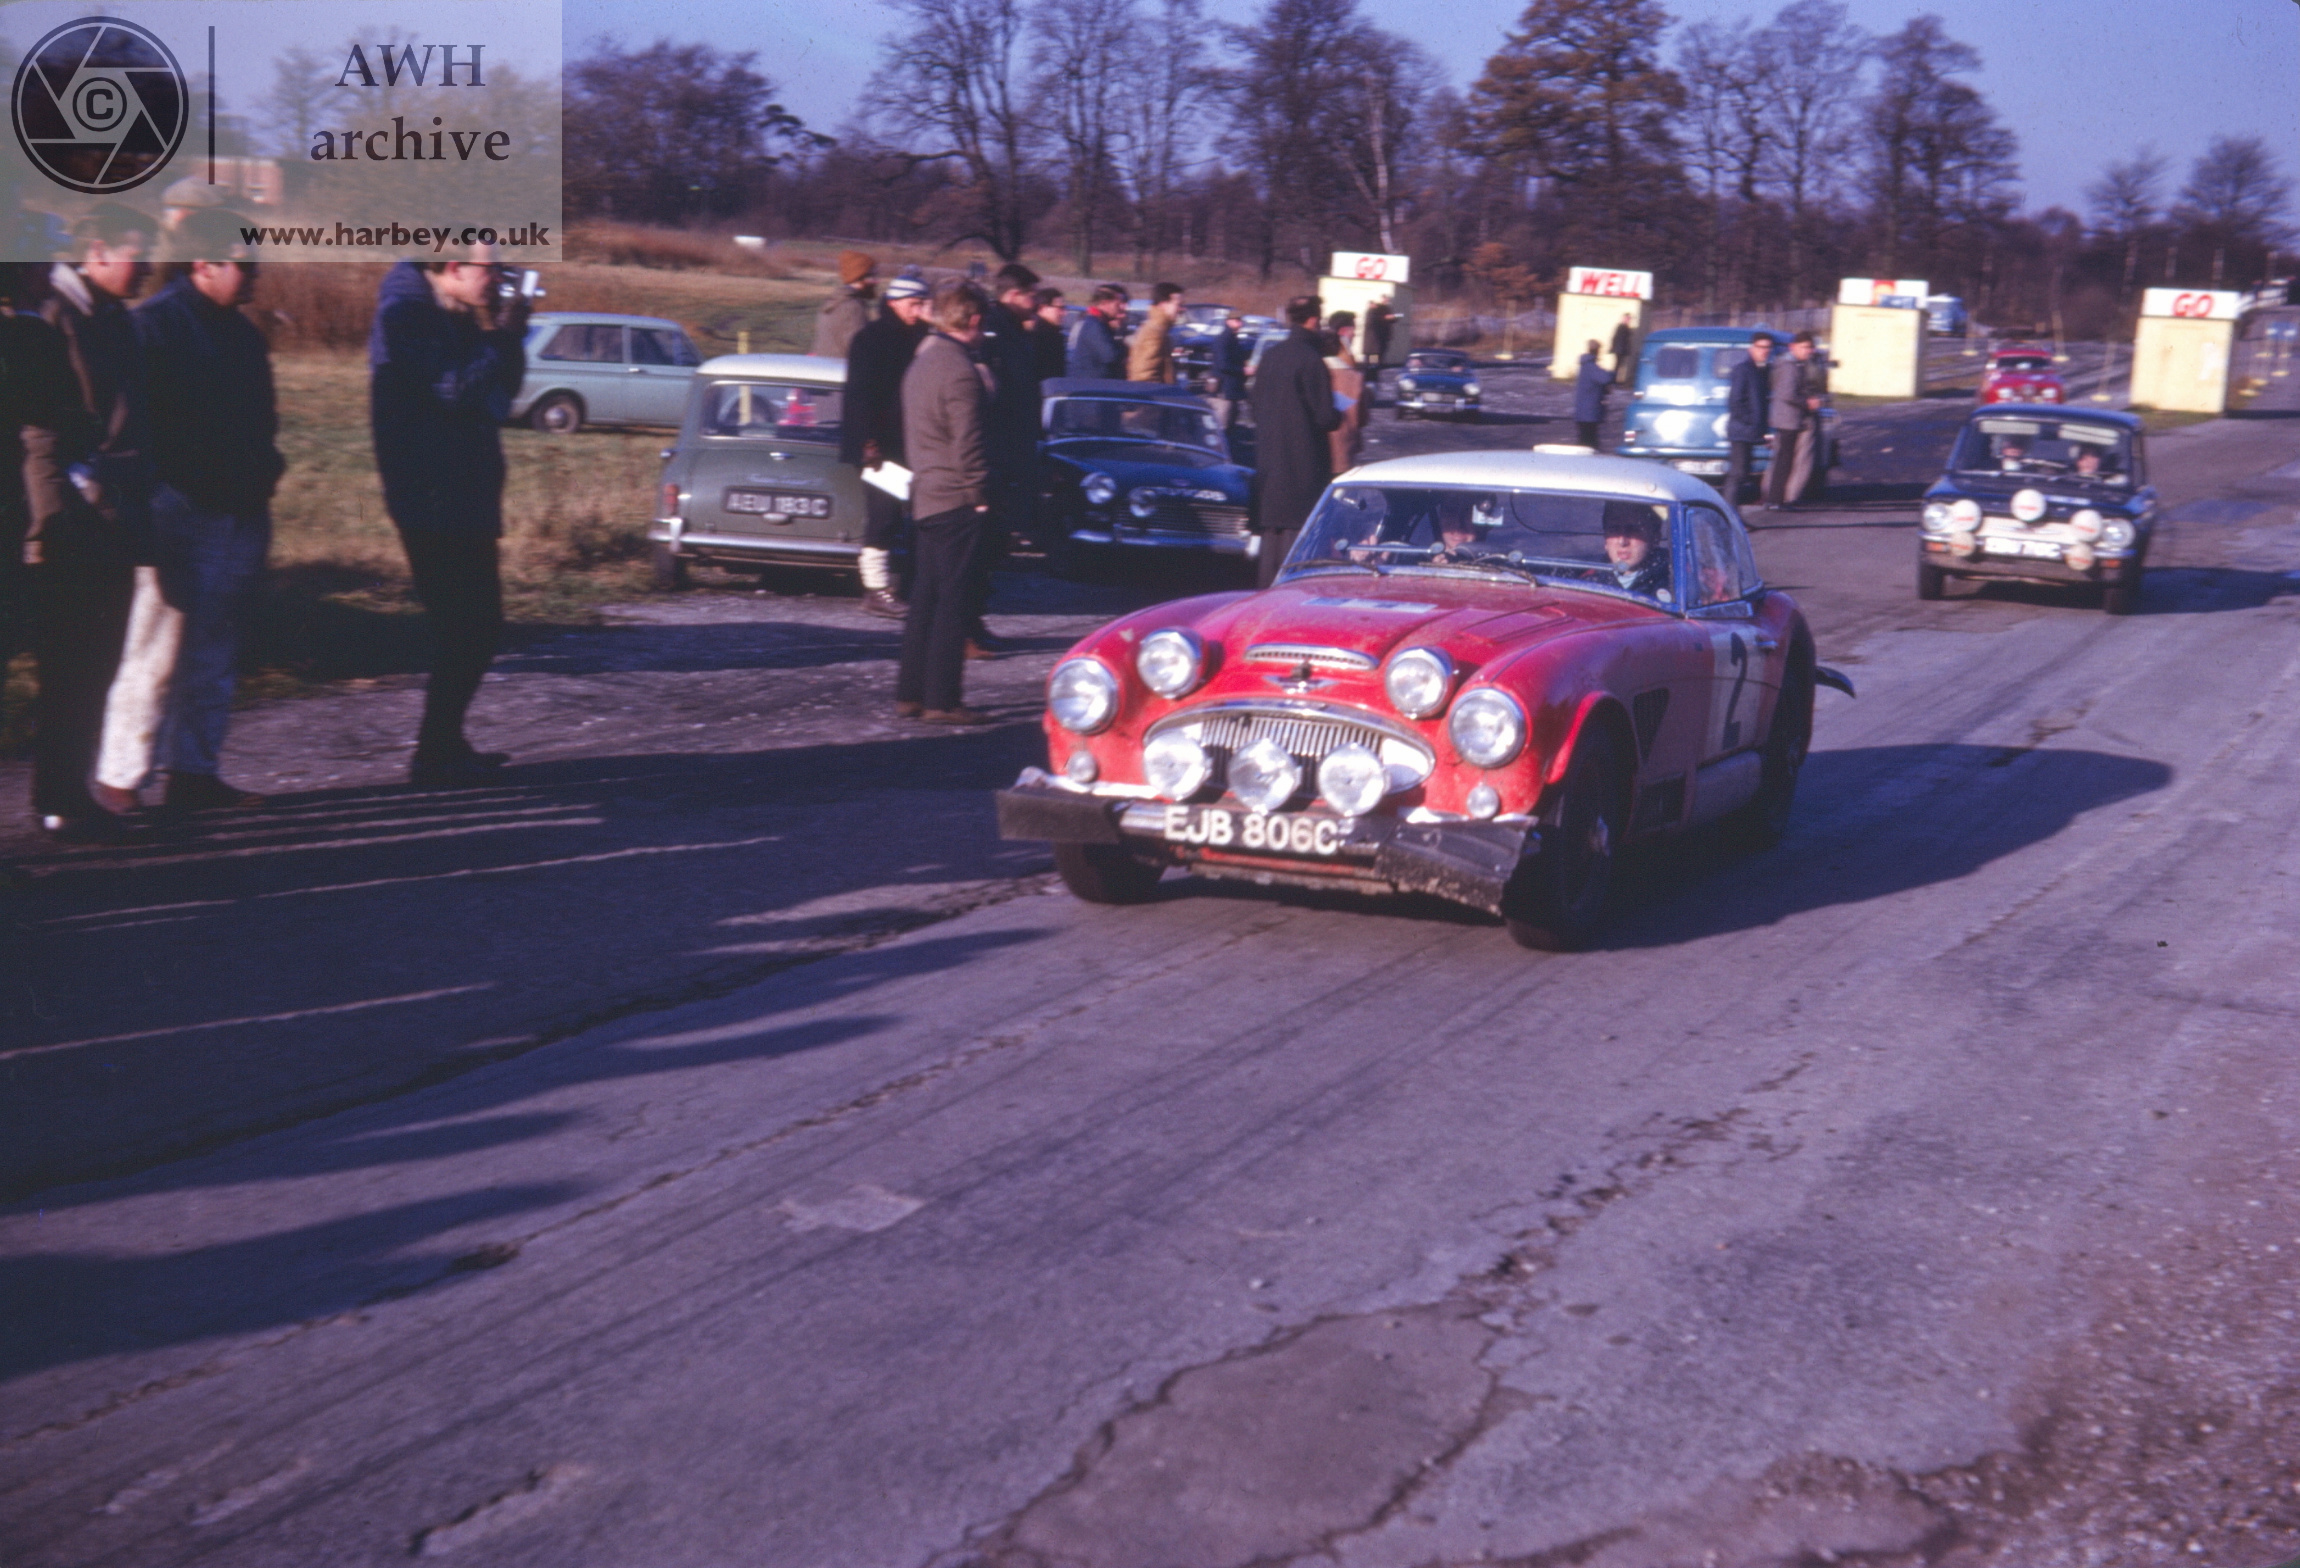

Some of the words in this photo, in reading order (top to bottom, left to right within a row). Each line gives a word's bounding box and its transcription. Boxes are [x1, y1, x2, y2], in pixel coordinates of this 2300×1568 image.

[1355, 256, 1388, 280] GO
[1580, 271, 1642, 298] WELL
[2171, 292, 2215, 318] GO
[1722, 631, 1748, 750] 2
[1164, 805, 1233, 845] EJB
[1242, 812, 1339, 855] 806C
